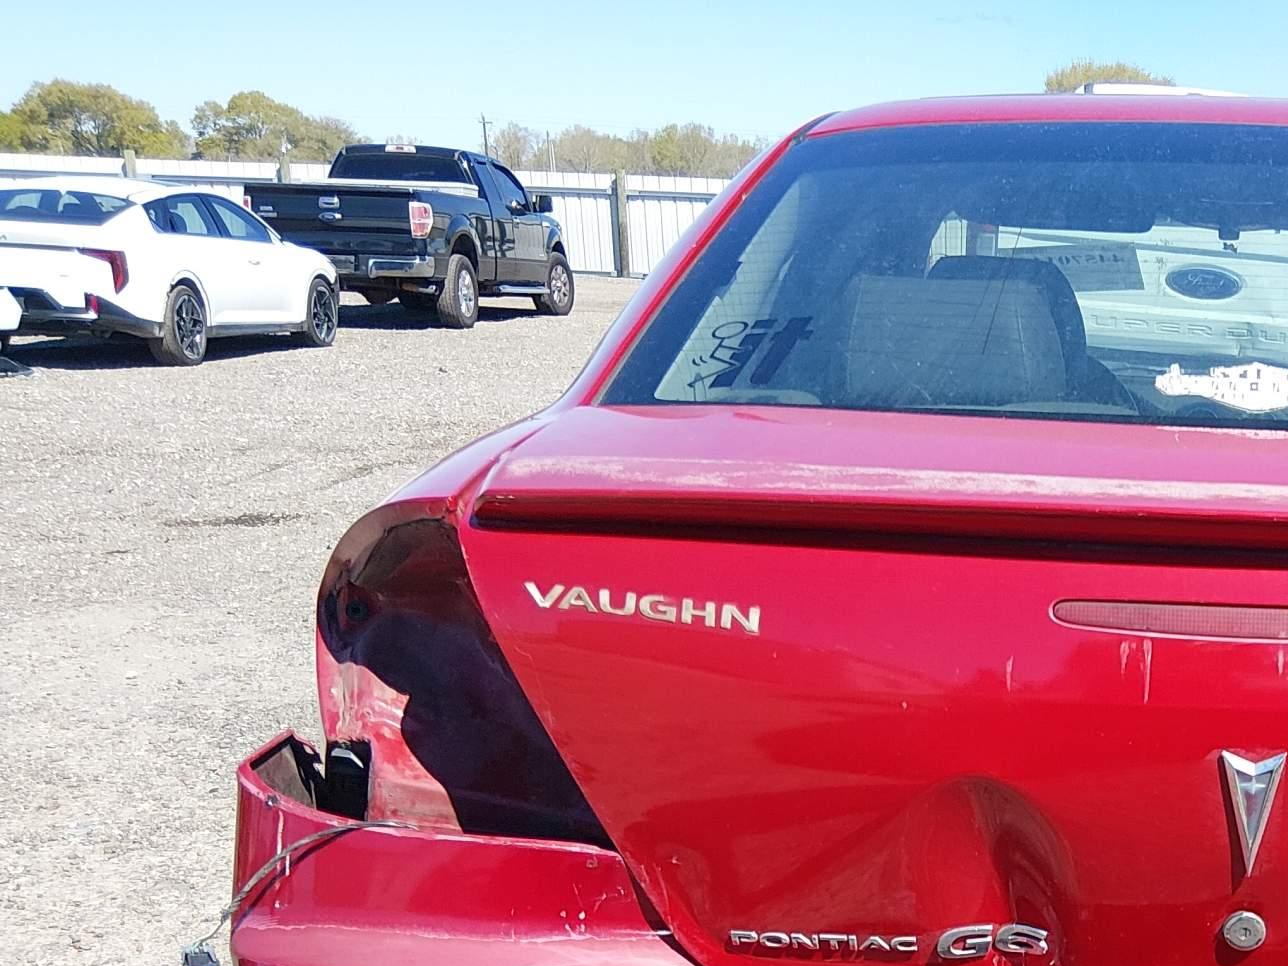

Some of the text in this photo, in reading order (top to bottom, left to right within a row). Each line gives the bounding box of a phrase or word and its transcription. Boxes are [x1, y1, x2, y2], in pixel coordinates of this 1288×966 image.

[1090, 313, 1213, 338] UPER
[523, 581, 761, 635] VAUGHN
[728, 923, 1048, 960] PONTIAC G6
